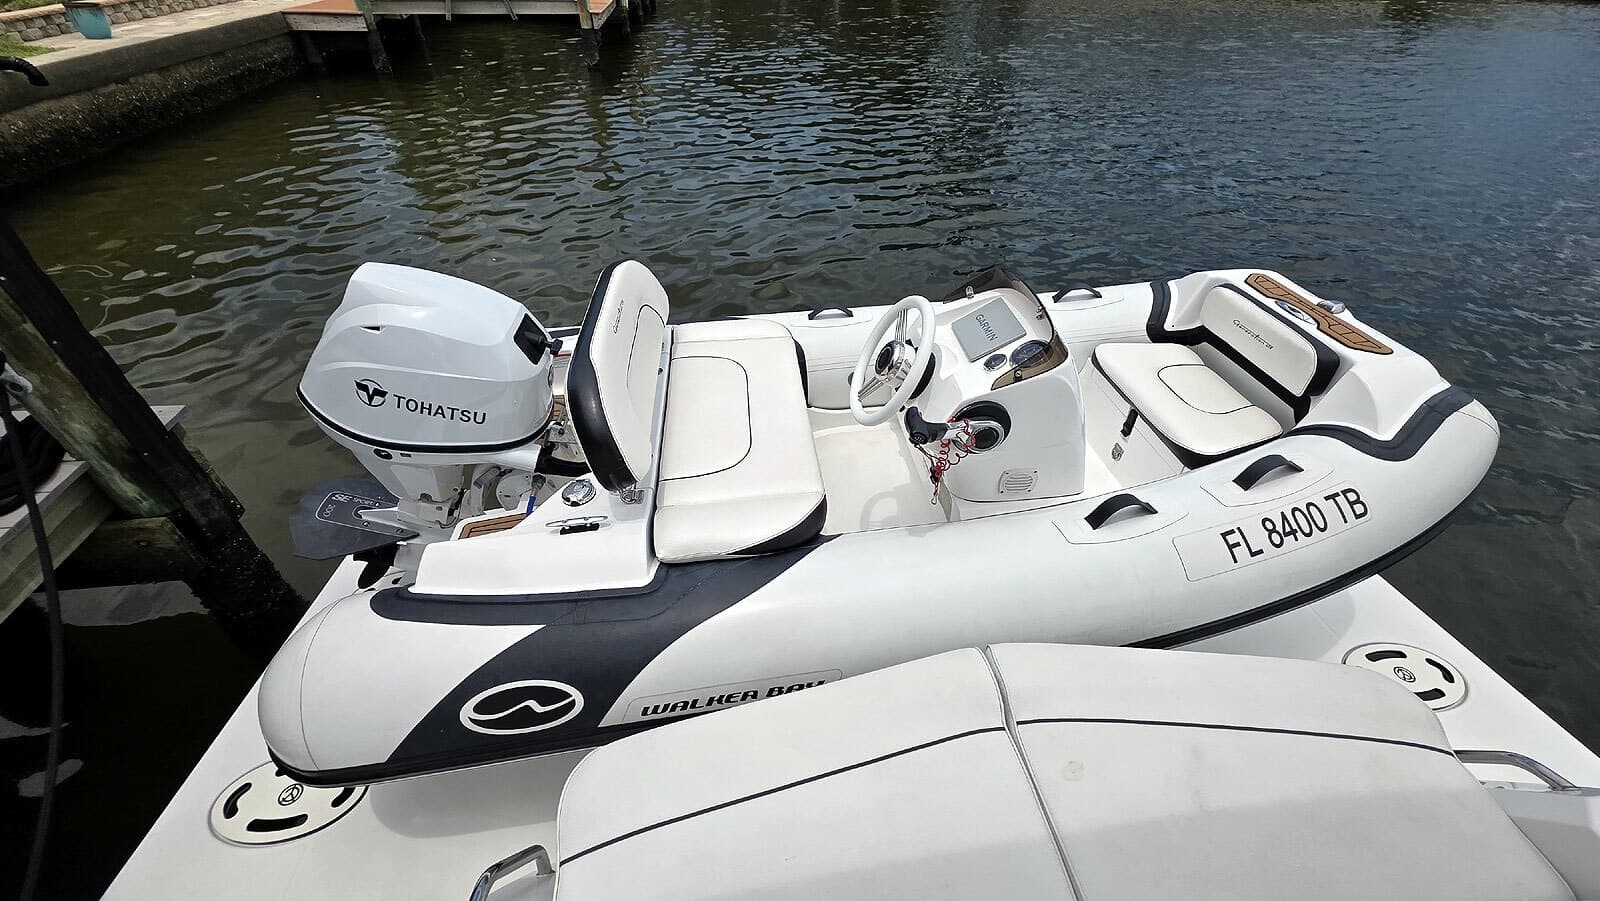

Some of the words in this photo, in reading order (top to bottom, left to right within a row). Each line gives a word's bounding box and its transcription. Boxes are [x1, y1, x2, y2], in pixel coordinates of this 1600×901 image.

[975, 313, 998, 342] GARMIN
[393, 394, 487, 425] TOHATSU
[1219, 527, 1264, 564] FL
[1261, 501, 1328, 549] 8400
[1323, 487, 1369, 524] TB
[640, 689, 759, 717] WALKER
